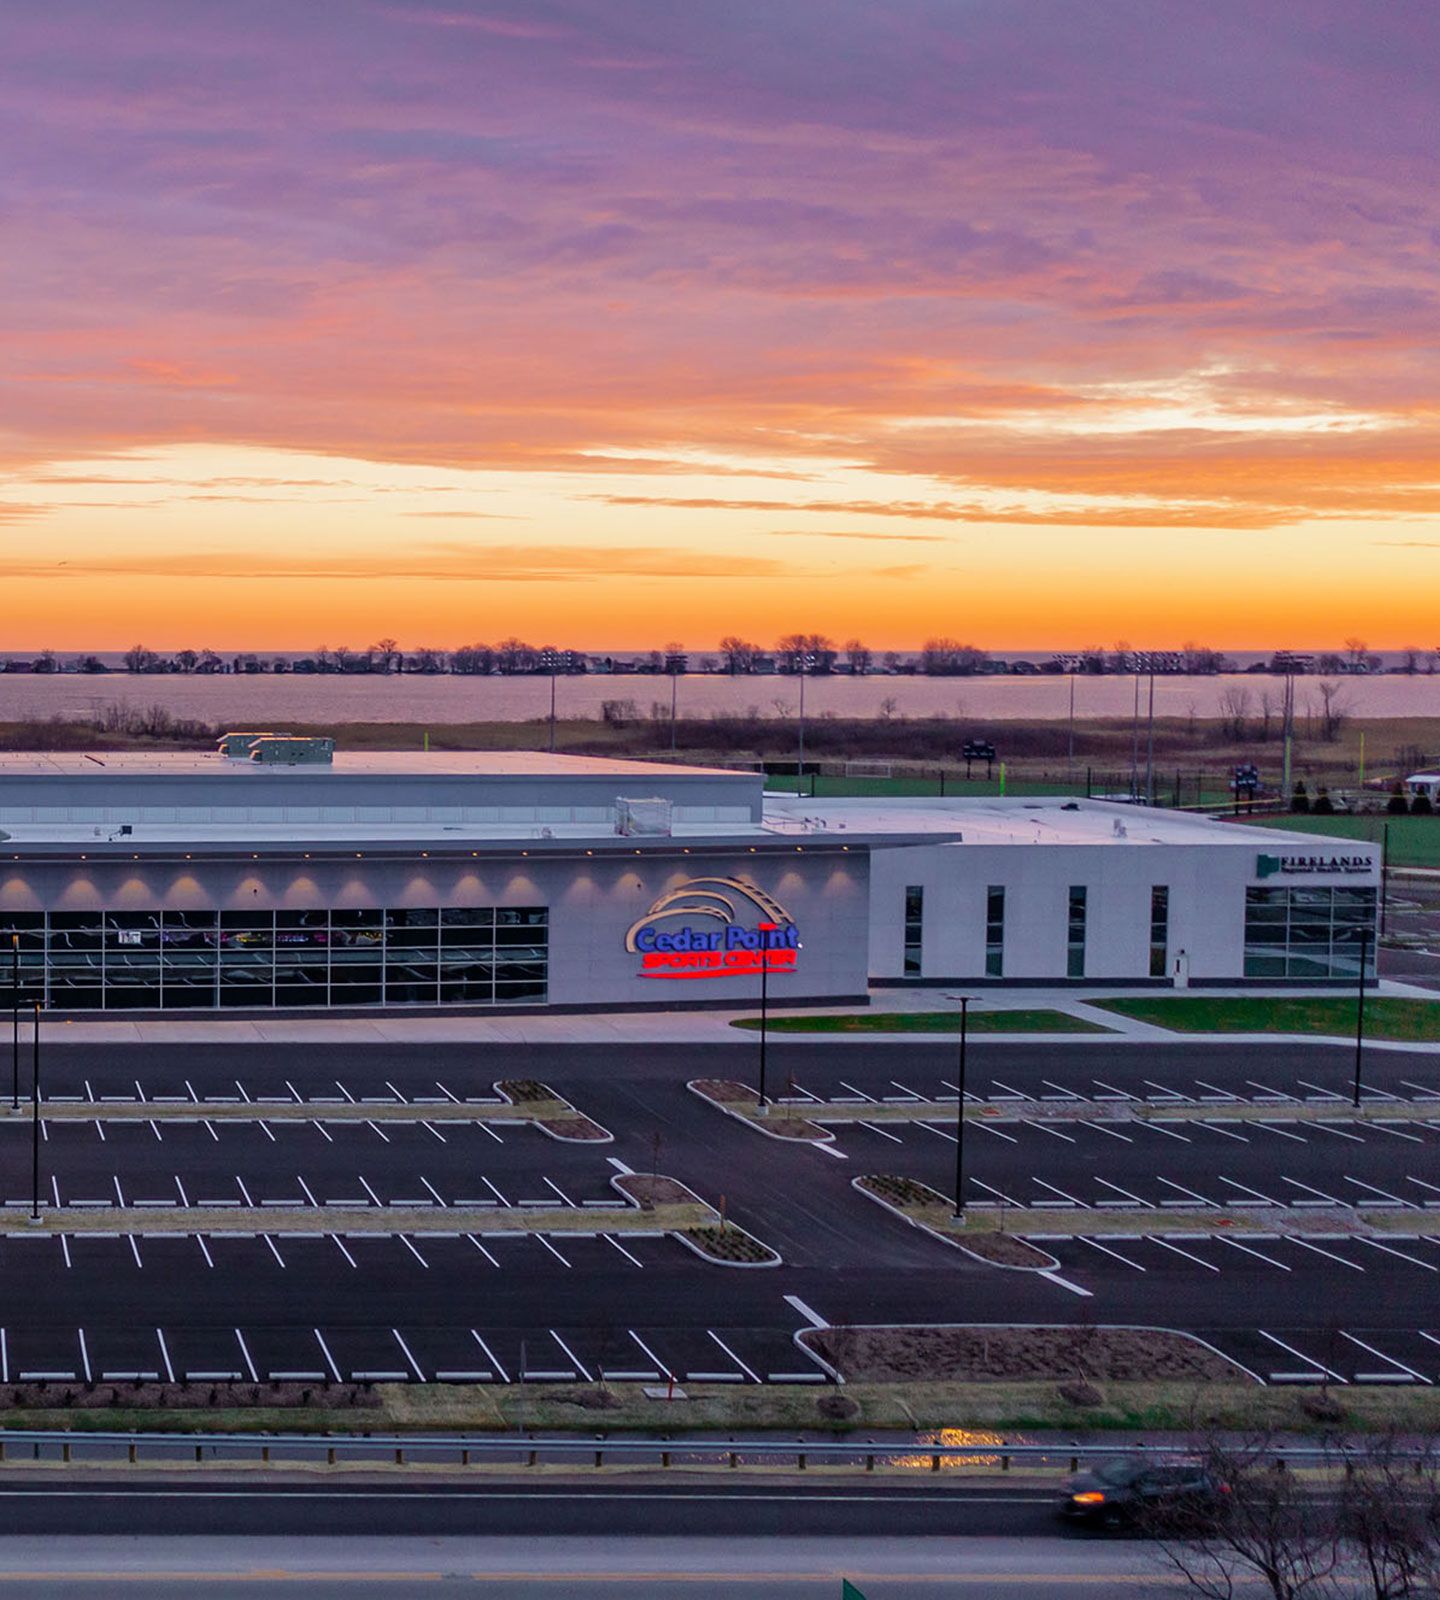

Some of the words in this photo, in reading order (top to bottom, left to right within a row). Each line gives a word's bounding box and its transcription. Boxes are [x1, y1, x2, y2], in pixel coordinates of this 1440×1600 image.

[1281, 856, 1372, 866] FIRELANDS
[636, 927, 722, 952] Cedar
[726, 922, 798, 950] Point
[643, 952, 722, 968] SPORTS
